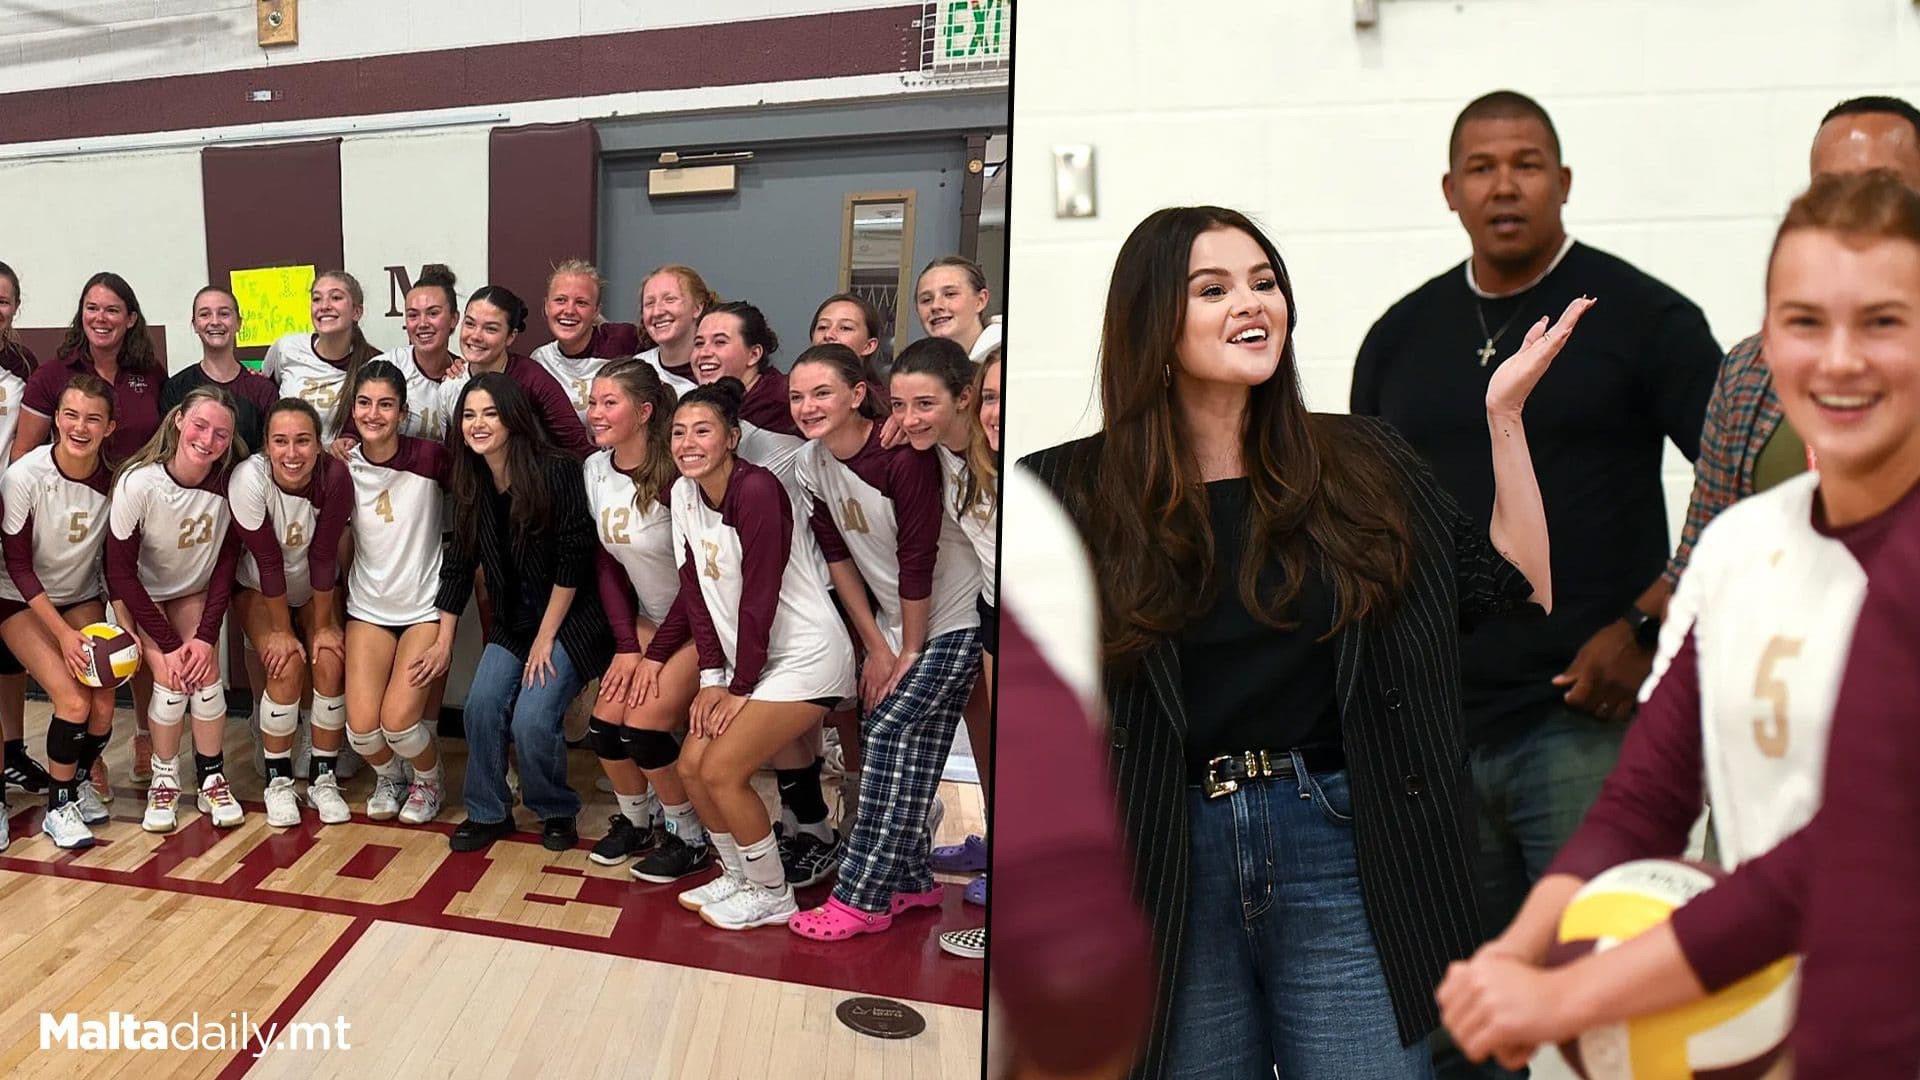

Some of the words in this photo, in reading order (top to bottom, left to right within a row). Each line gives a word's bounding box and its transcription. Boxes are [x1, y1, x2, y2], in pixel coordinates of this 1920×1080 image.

[299, 379, 336, 409] 25
[375, 489, 394, 523] 4
[68, 511, 89, 544] 5
[177, 513, 213, 549] 23
[285, 522, 304, 547] 6
[601, 507, 631, 544] 12
[1753, 634, 1805, 759] 5
